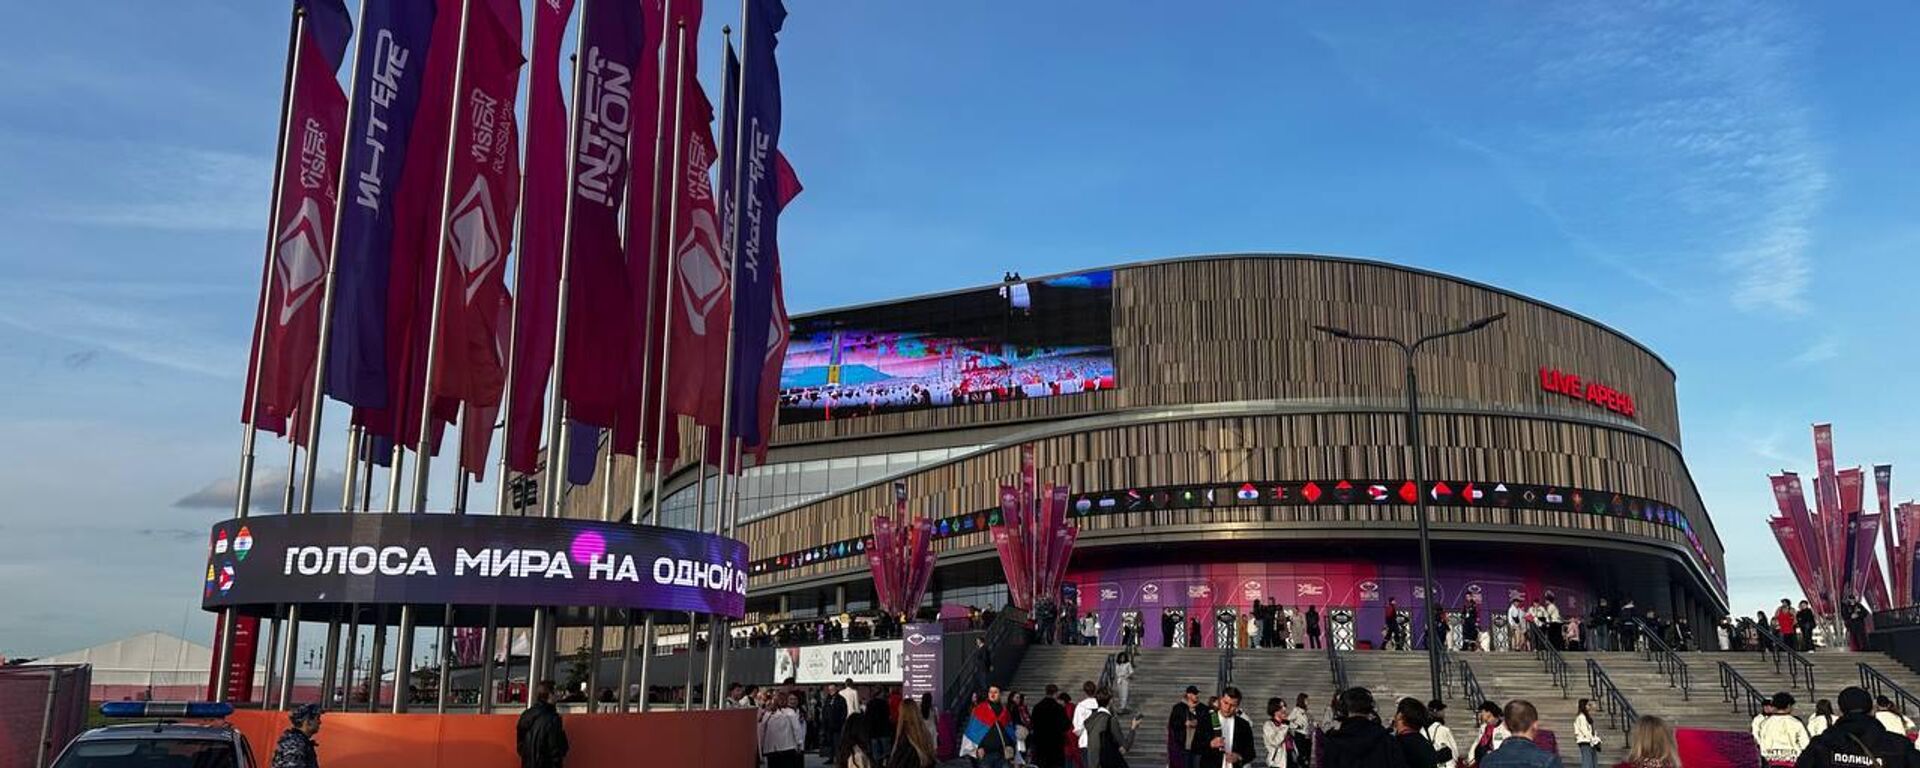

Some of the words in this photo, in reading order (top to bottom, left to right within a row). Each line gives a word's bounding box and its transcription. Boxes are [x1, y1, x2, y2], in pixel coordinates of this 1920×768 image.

[1539, 365, 1584, 398] LIVE
[1586, 382, 1636, 417] АРЕНА
[283, 545, 437, 577] ГОЛОСА
[454, 547, 574, 580] МИРА
[588, 553, 639, 582] НА
[652, 555, 734, 593] ОДНОЙ
[831, 647, 892, 676] СЫРОВАРНЯ
